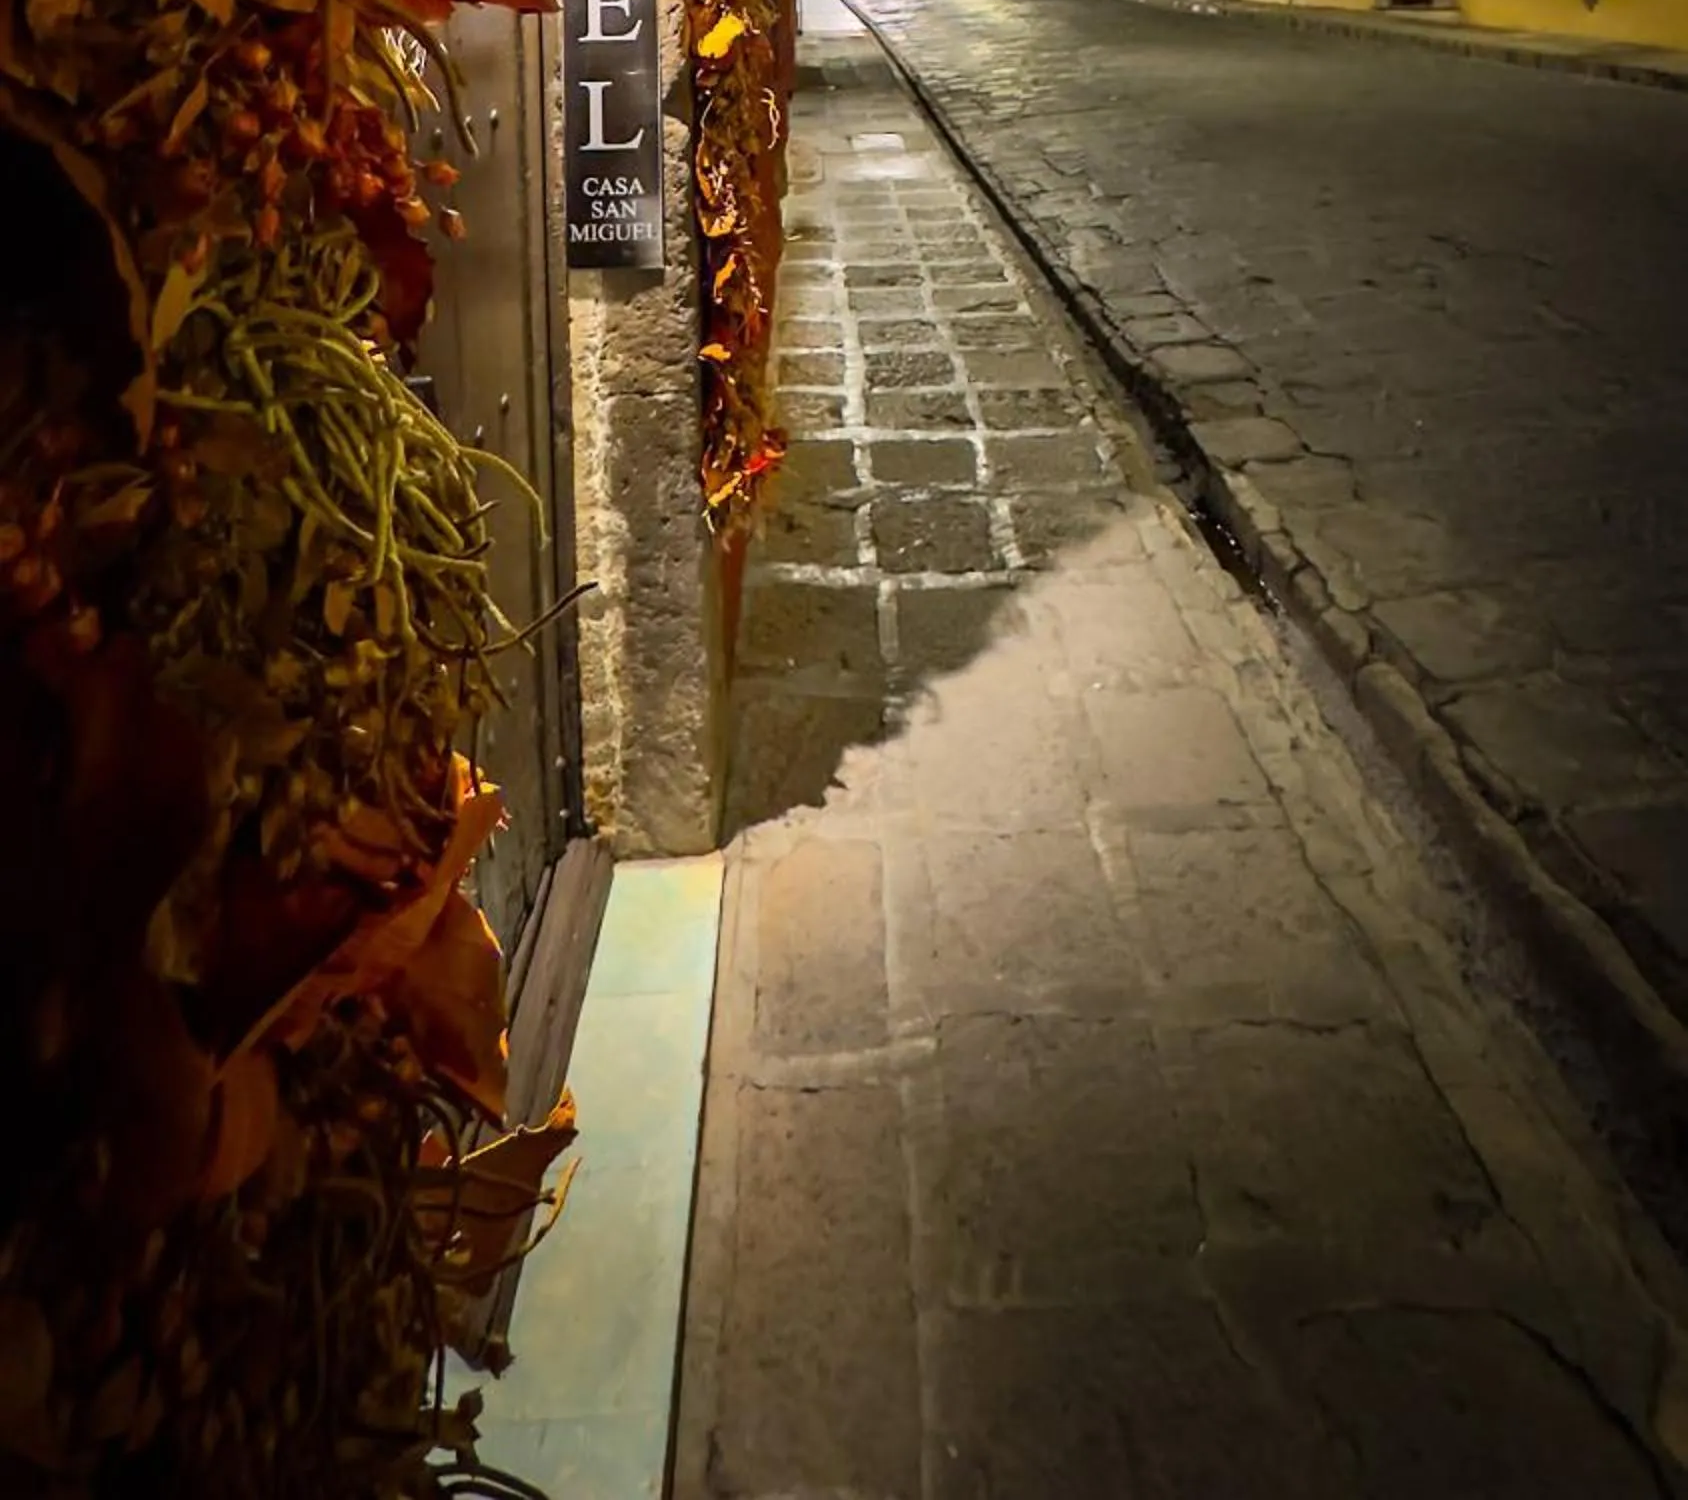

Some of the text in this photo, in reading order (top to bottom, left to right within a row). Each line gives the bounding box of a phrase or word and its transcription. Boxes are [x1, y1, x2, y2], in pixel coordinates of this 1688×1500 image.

[582, 176, 645, 197] CASA
[591, 200, 637, 219] SAN
[569, 223, 658, 243] MIGUEL
